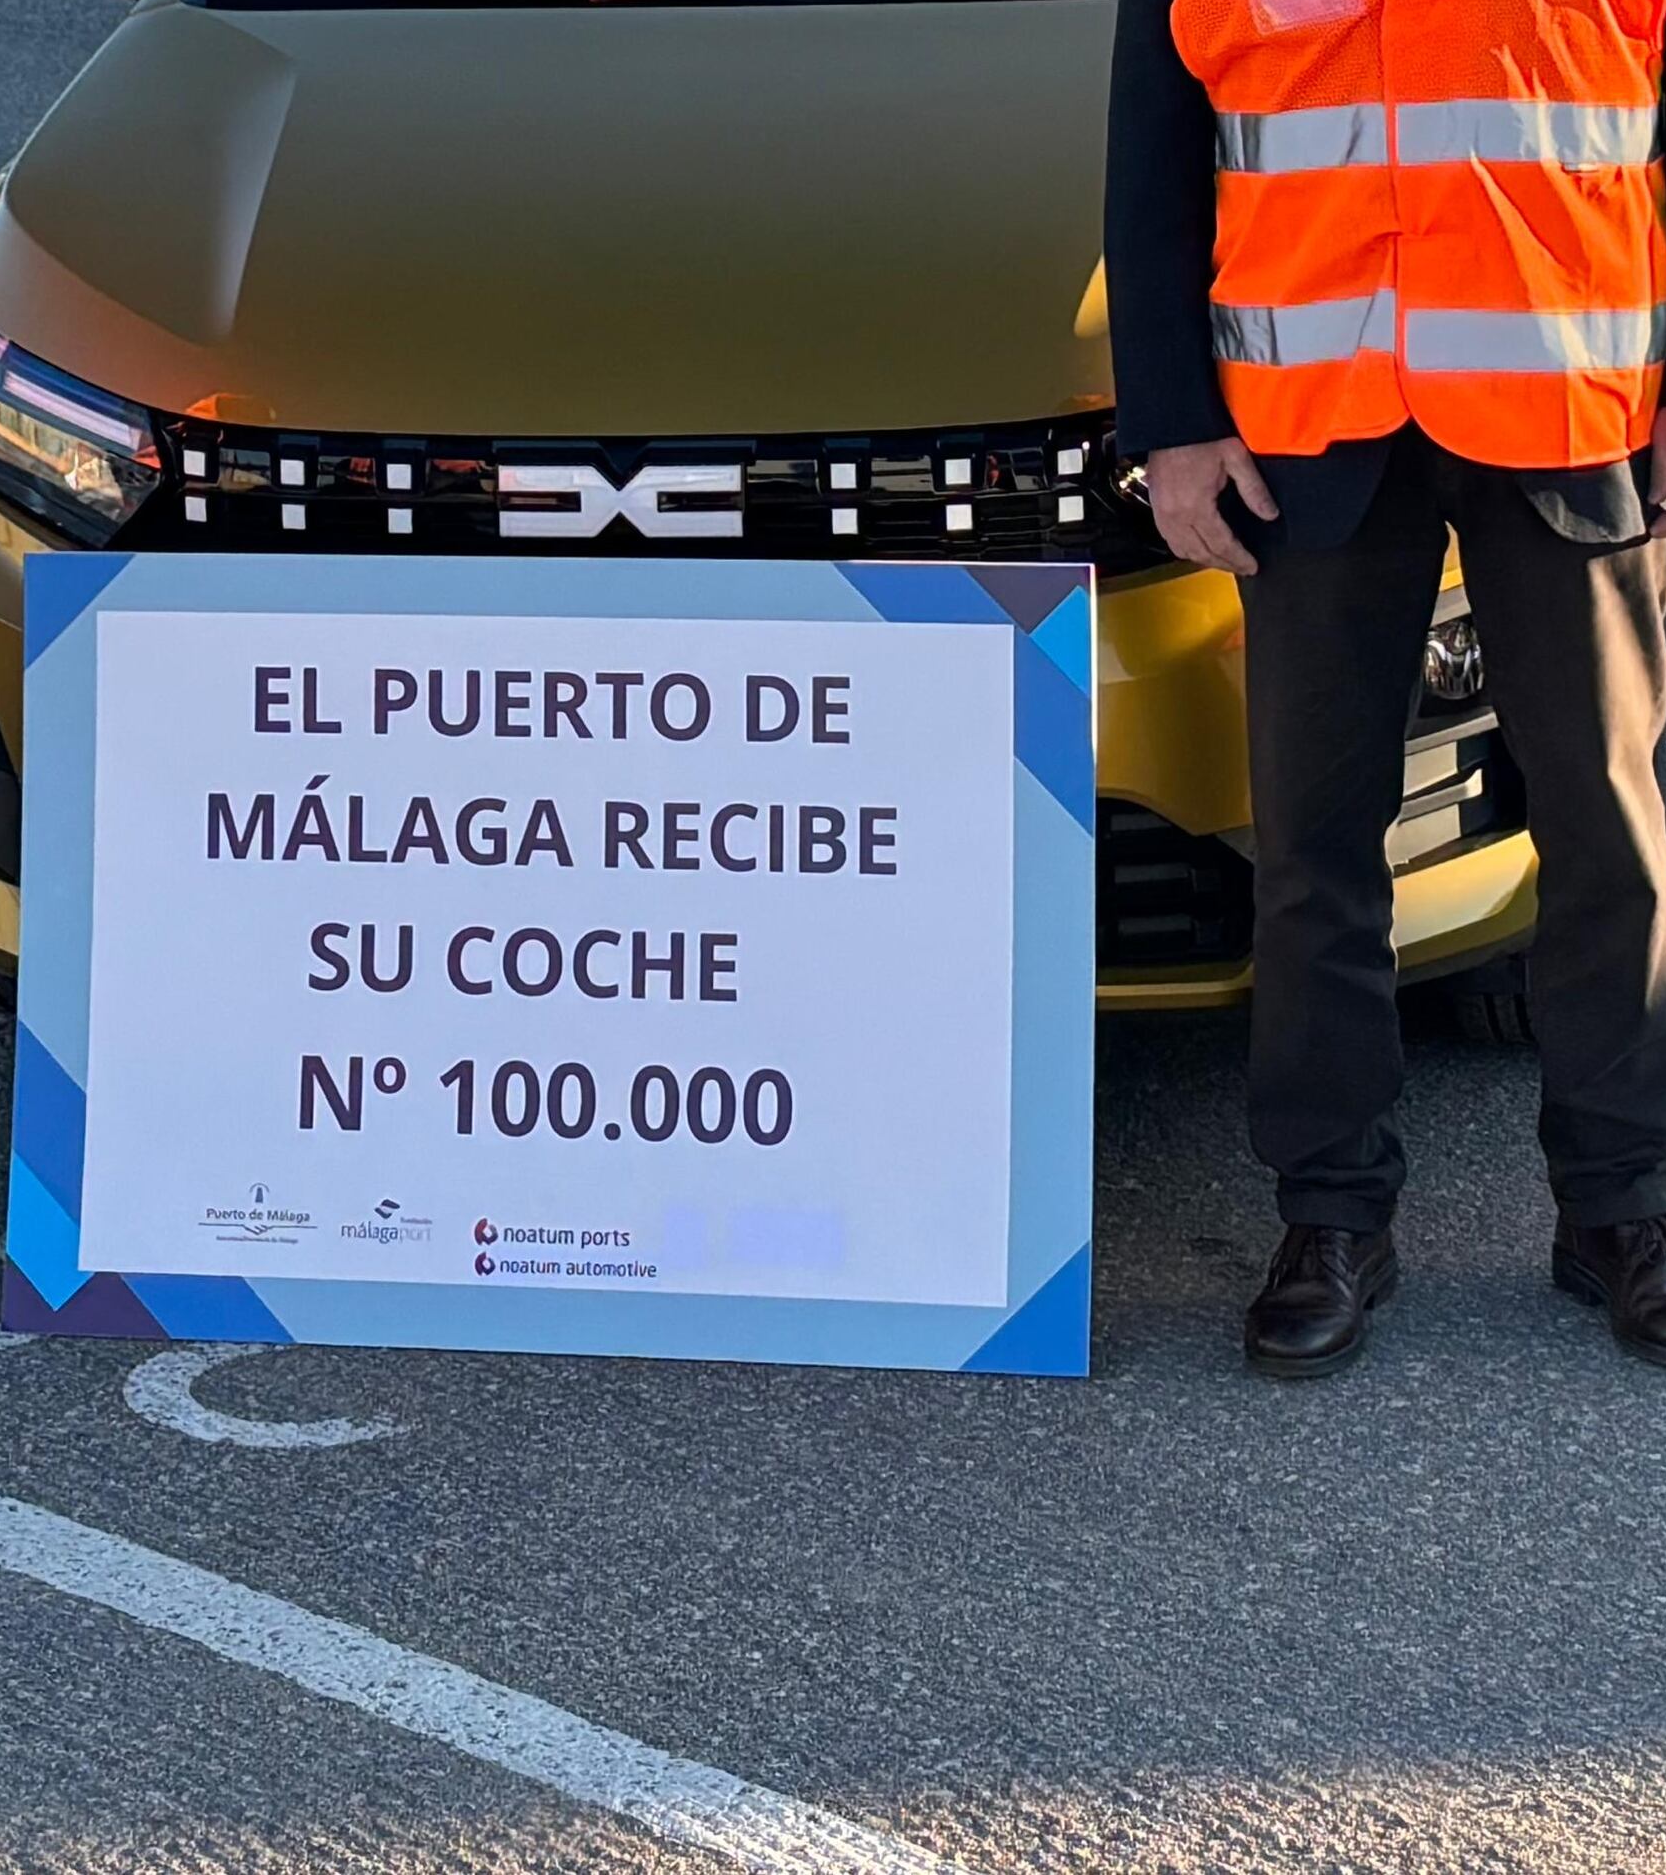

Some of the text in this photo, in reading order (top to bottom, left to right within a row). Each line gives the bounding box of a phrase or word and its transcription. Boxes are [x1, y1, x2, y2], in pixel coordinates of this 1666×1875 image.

[254, 666, 851, 745] EL PUERTO DE
[207, 774, 898, 876] MÁLAGA RECIBE
[308, 922, 738, 1002] SU COCHE
[439, 1059, 793, 1146] 100.000
[206, 1207, 247, 1221] Puerto
[503, 1226, 630, 1249] noatum ports
[499, 1259, 657, 1278] noatum automotive
